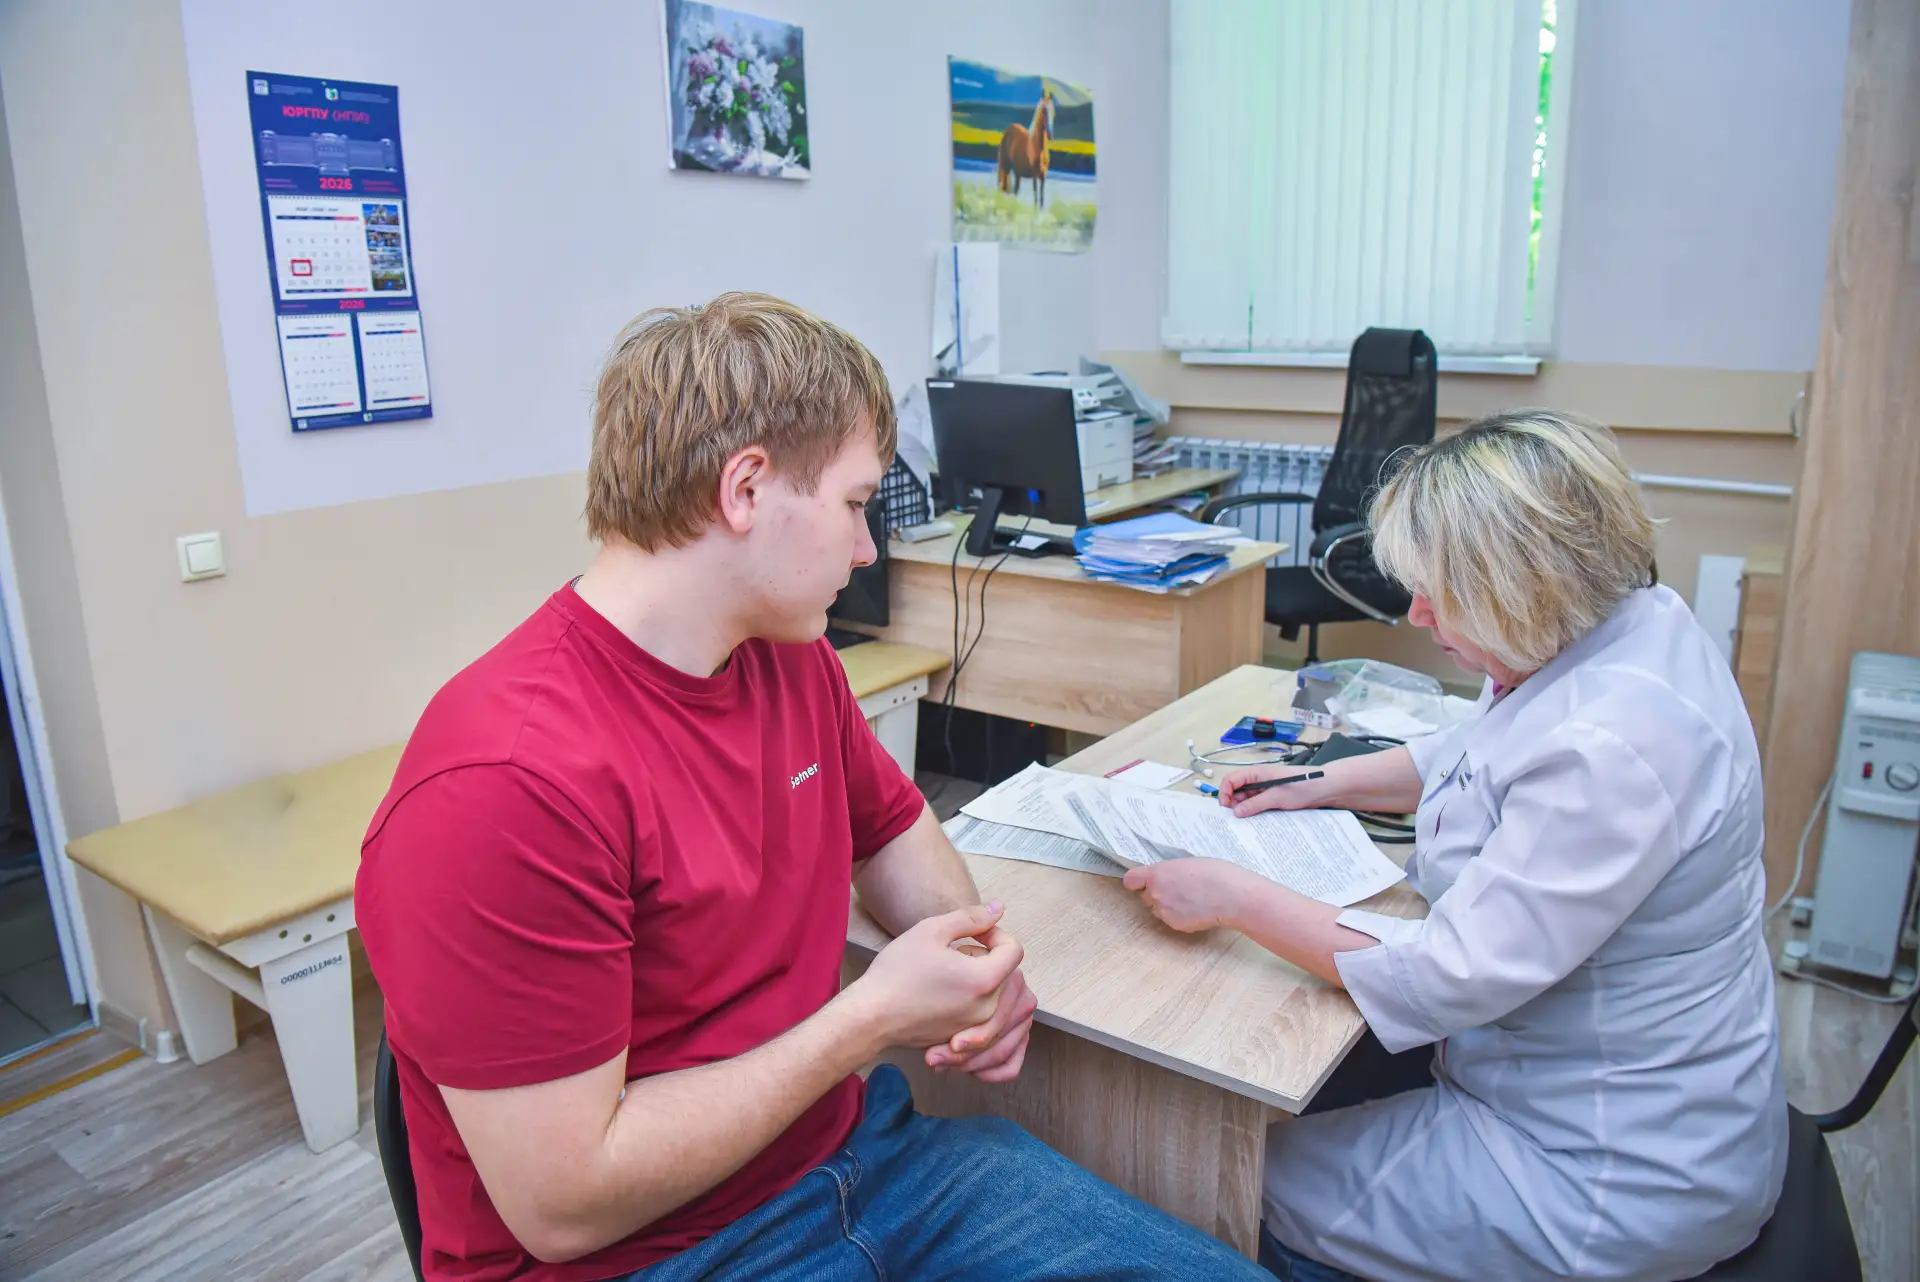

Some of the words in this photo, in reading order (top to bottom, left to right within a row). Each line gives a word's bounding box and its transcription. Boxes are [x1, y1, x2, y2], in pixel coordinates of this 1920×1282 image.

[282, 105, 329, 120] ЮРГПУ
[332, 109, 371, 124] (НПИ)
[319, 177, 354, 190] 2026
